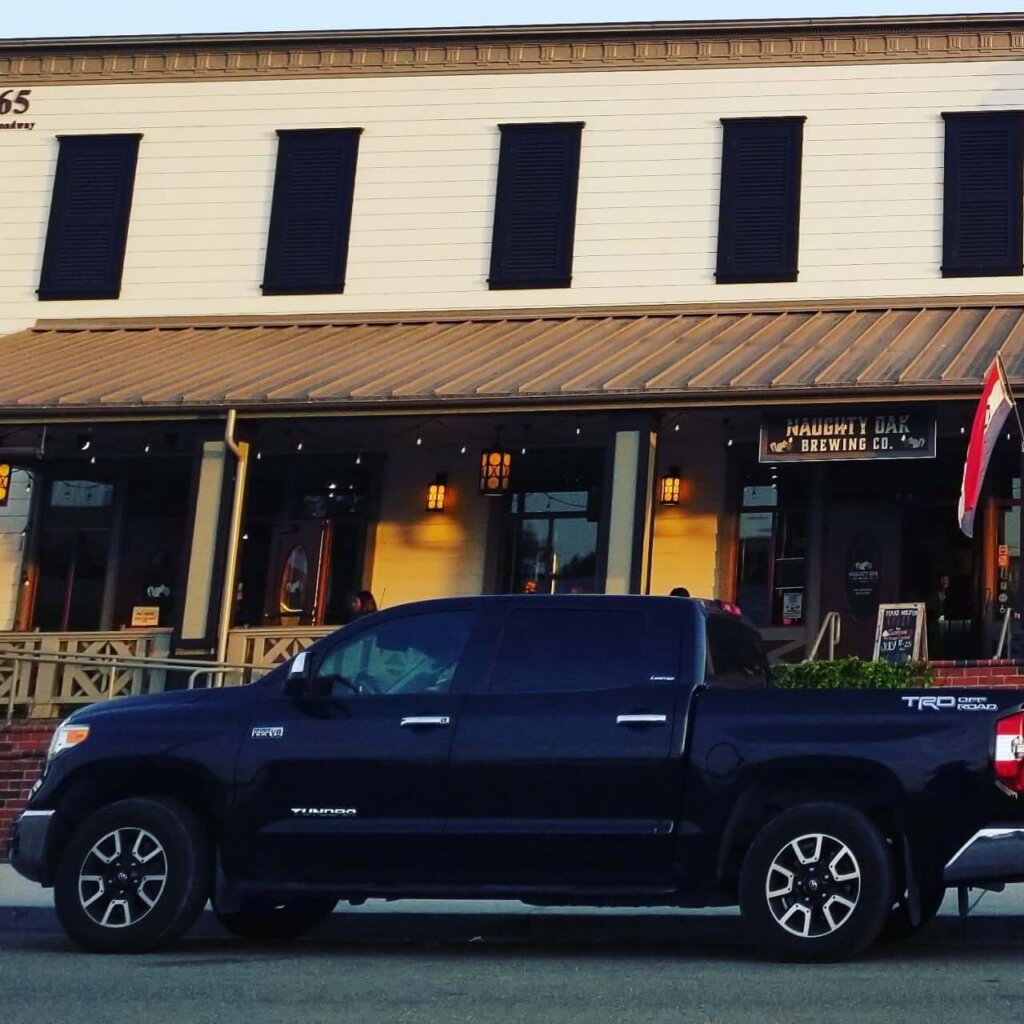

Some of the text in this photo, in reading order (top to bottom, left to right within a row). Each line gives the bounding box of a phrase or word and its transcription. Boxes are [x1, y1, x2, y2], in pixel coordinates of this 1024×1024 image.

[0, 89, 31, 114] 65
[786, 414, 911, 437] NAUGHTY OAK
[801, 437, 893, 452] BREWING CO.
[902, 696, 956, 710] TRD
[957, 703, 998, 711] ROAD
